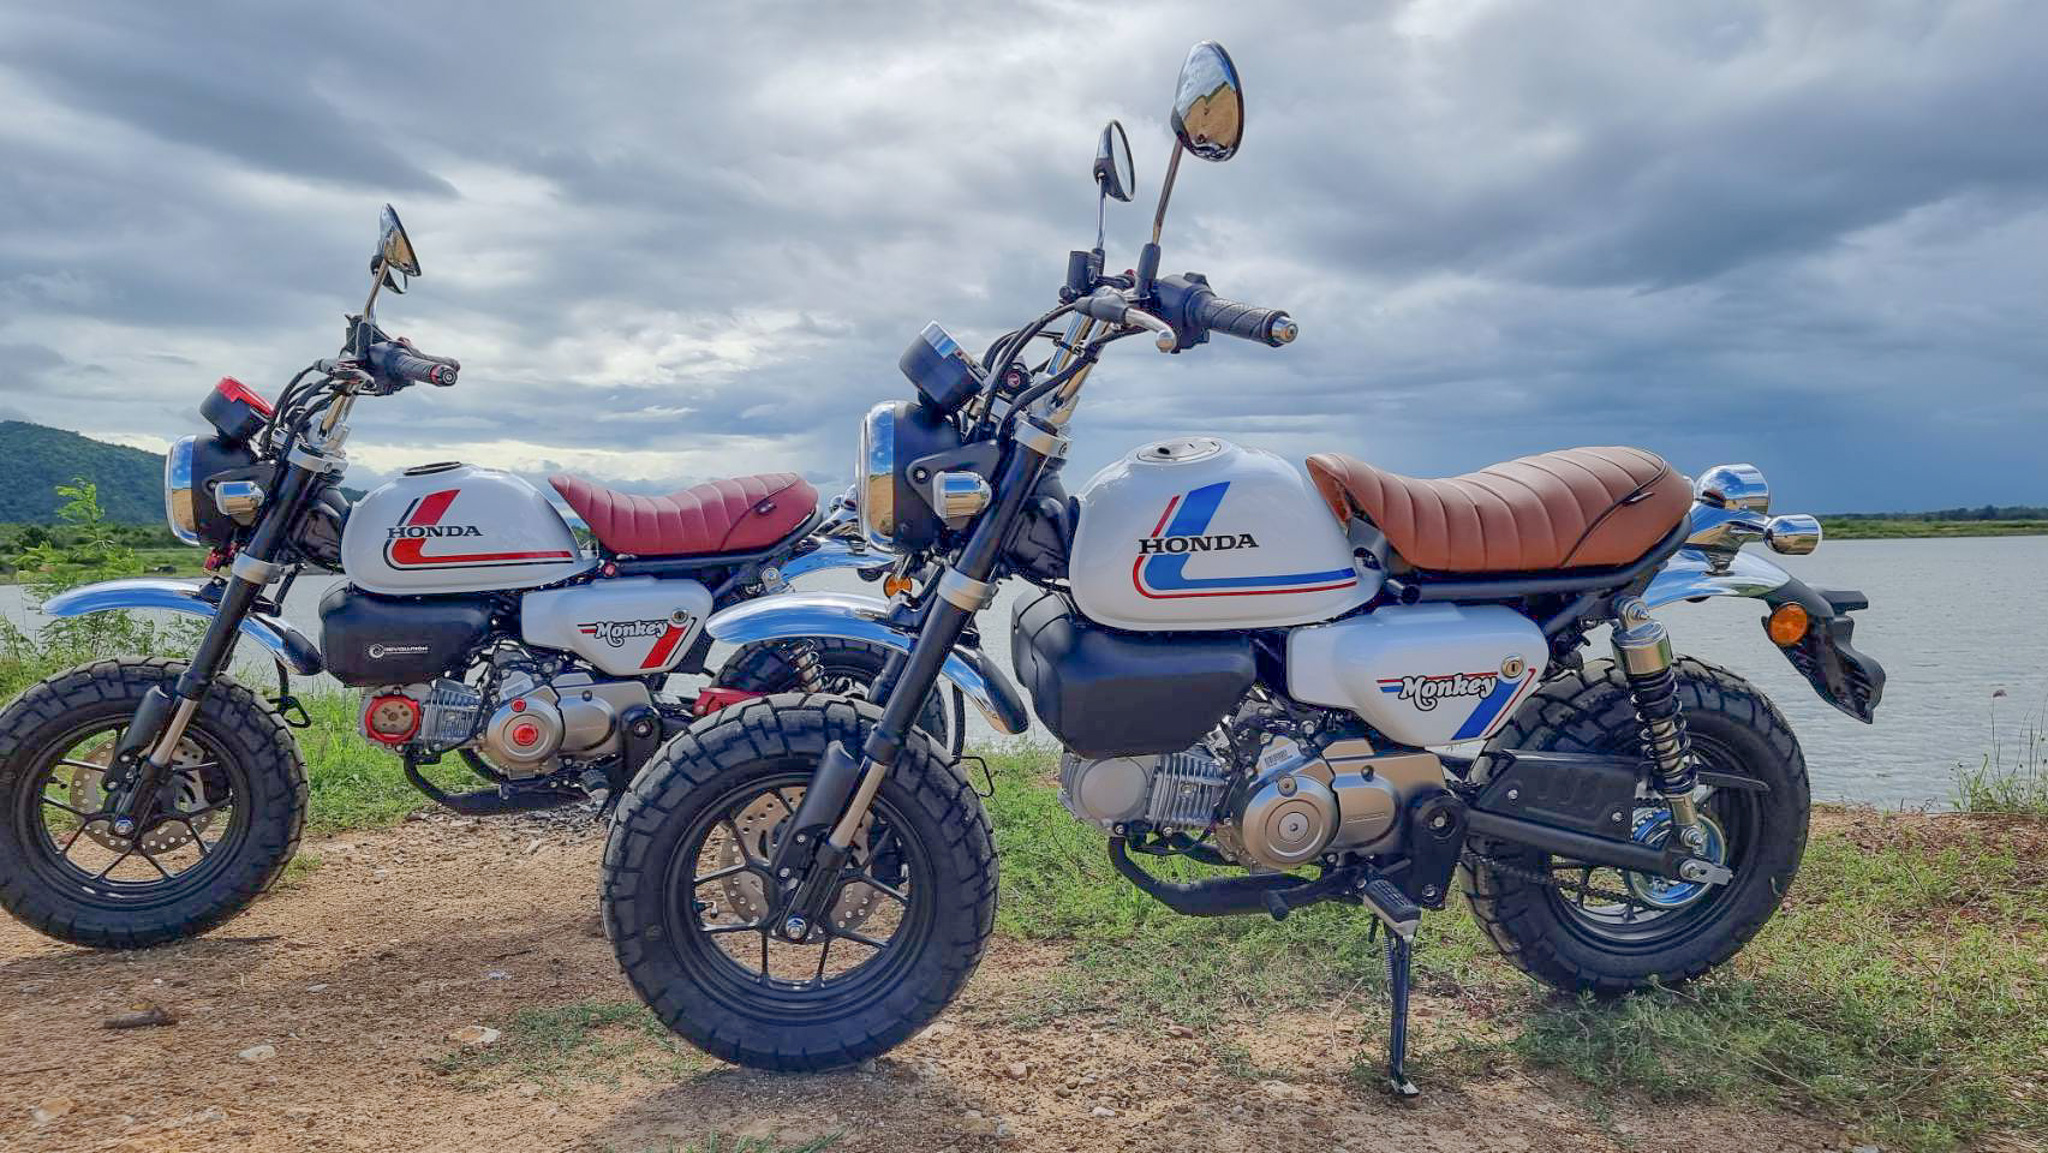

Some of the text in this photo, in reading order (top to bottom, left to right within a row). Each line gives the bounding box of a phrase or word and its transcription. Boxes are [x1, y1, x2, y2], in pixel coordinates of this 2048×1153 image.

[387, 525, 484, 539] HONDA
[1138, 533, 1260, 555] HONDA
[594, 620, 670, 648] Monkey
[1398, 672, 1499, 712] Monkey
